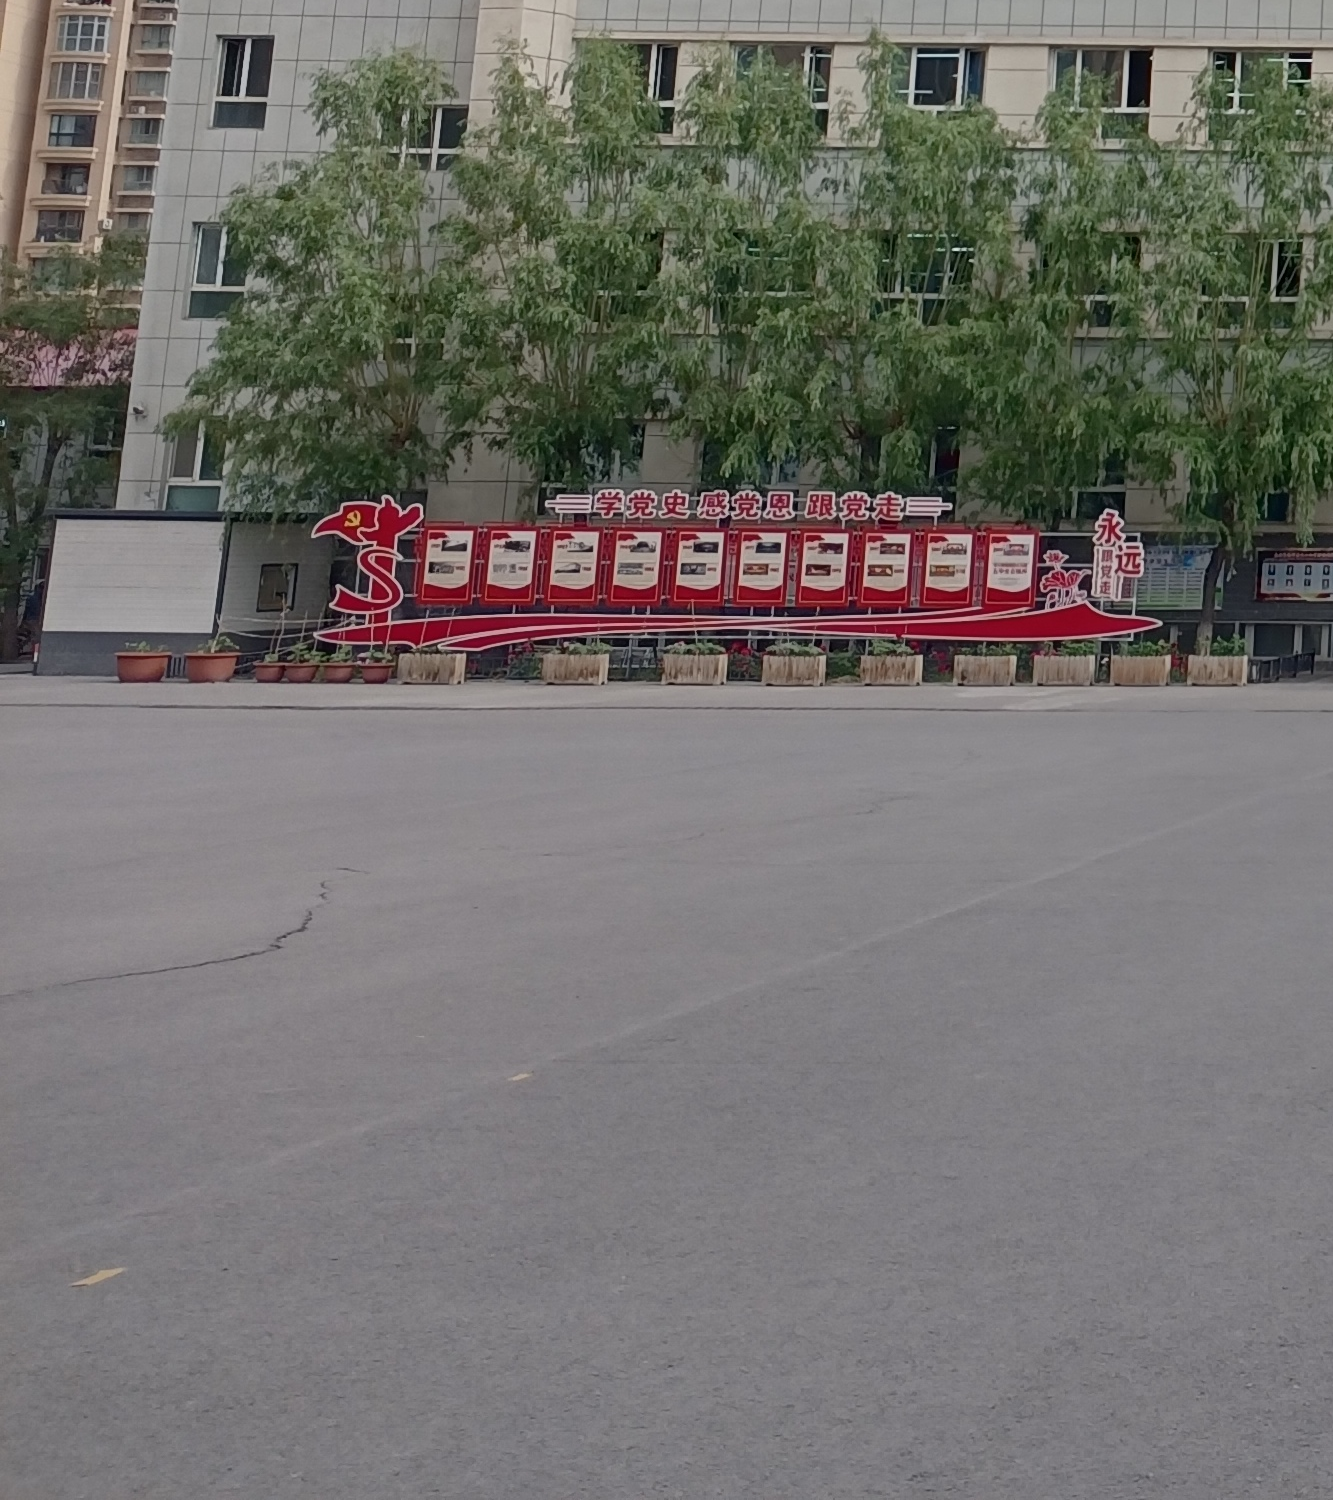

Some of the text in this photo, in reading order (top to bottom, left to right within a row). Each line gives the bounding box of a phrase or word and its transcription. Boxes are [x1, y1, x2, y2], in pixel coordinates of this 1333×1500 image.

[595, 490, 904, 521] 学党史 感党恩 跟党走
[1096, 511, 1142, 575] 永远
